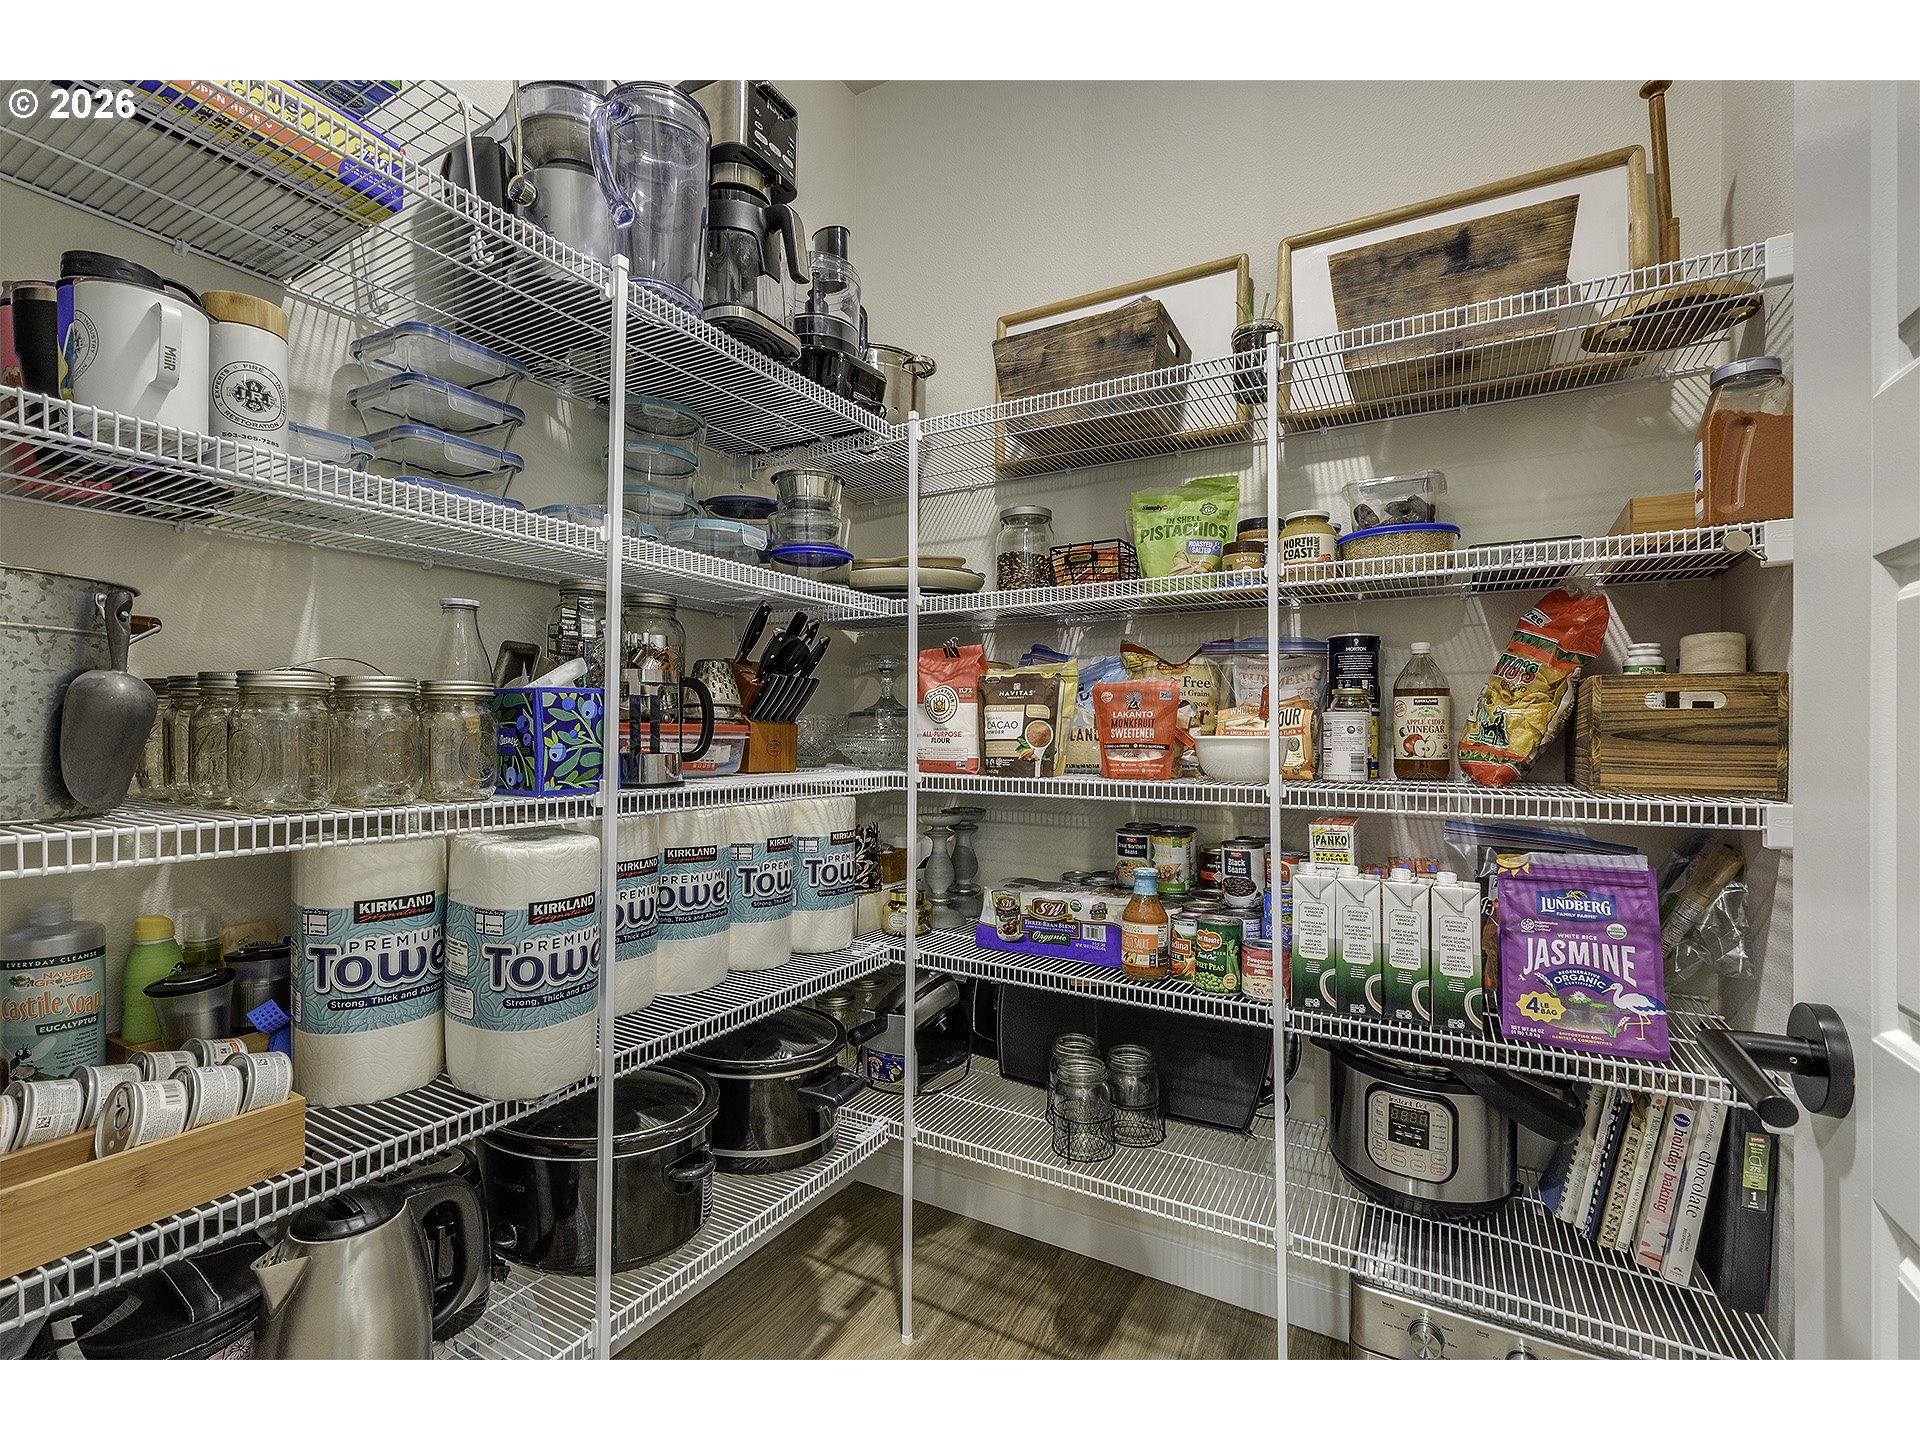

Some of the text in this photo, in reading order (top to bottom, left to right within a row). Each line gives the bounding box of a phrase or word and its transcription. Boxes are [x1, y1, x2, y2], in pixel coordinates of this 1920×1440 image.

[83, 318, 97, 354] INDUSTRY
[165, 345, 177, 372] MiiR
[243, 363, 264, 374] FIRE
[214, 368, 230, 398] EXPERTS
[224, 409, 279, 430] RESTORATION
[1176, 515, 1201, 525] SHELL
[1140, 522, 1228, 543] PISTACHIOS
[1188, 540, 1212, 548] ROASTED
[1284, 536, 1314, 550] NORTH
[1284, 547, 1314, 560] COAST
[1526, 609, 1544, 626] ree
[1183, 676, 1212, 689] Free
[1188, 690, 1211, 698] Grains
[987, 720, 1019, 729] CACAO
[1111, 719, 1155, 728] MONKFRUIT
[1406, 718, 1425, 726] APPLE
[1406, 725, 1446, 734] VINEGAR
[1110, 728, 1155, 739] SWEETENER
[1315, 834, 1347, 846] PANKO
[667, 847, 715, 858] KIRKLAND
[617, 857, 658, 872] KIRKLAND
[1228, 858, 1246, 867] Black
[1228, 865, 1247, 874] Beans
[662, 871, 722, 884] PREMIUM
[805, 860, 853, 885] Tow
[660, 868, 731, 909] owel
[738, 867, 792, 897] Tow
[619, 884, 658, 901] REMIU
[360, 894, 433, 914] KIRKLAND
[533, 895, 594, 915] KIRKLAND
[1540, 896, 1612, 916] LUNDBERG
[359, 907, 433, 923] Signature
[533, 907, 593, 924] Signature
[349, 925, 442, 953] PREMIUM
[524, 927, 598, 953] PREMIUM
[624, 933, 639, 941] Thick
[1032, 931, 1067, 943] Organic
[1133, 937, 1150, 949] SAUCE
[6, 950, 97, 969] EVERYDAY CLEANSE
[309, 939, 445, 989] Towe
[484, 938, 600, 987] Towe
[1208, 963, 1225, 971] PEAS
[1246, 956, 1273, 965] Sweetene
[1246, 962, 1273, 970] Condense
[1523, 938, 1638, 988] JASMINE
[34, 970, 94, 988] GROCERS
[43, 966, 91, 980] NATURAL
[1558, 970, 1601, 980] REGENERATIVE
[1554, 974, 1607, 989] ORGANIC
[331, 988, 418, 1010] Strong, Thick and
[506, 988, 580, 1007] Strong, Thick and
[1526, 997, 1540, 1013] 4
[1, 991, 101, 1021] Castile Soap
[40, 1016, 98, 1033] EUCALYPTUS
[1558, 1031, 1590, 1039] SUPPORTING
[1578, 1038, 1612, 1046] COMMUNITIES
[1704, 1119, 1718, 1148] COOKING
[1653, 1127, 1687, 1214] holiday baking
[1685, 1149, 1715, 1219] chocolate
[1751, 1192, 1757, 1200] 1
